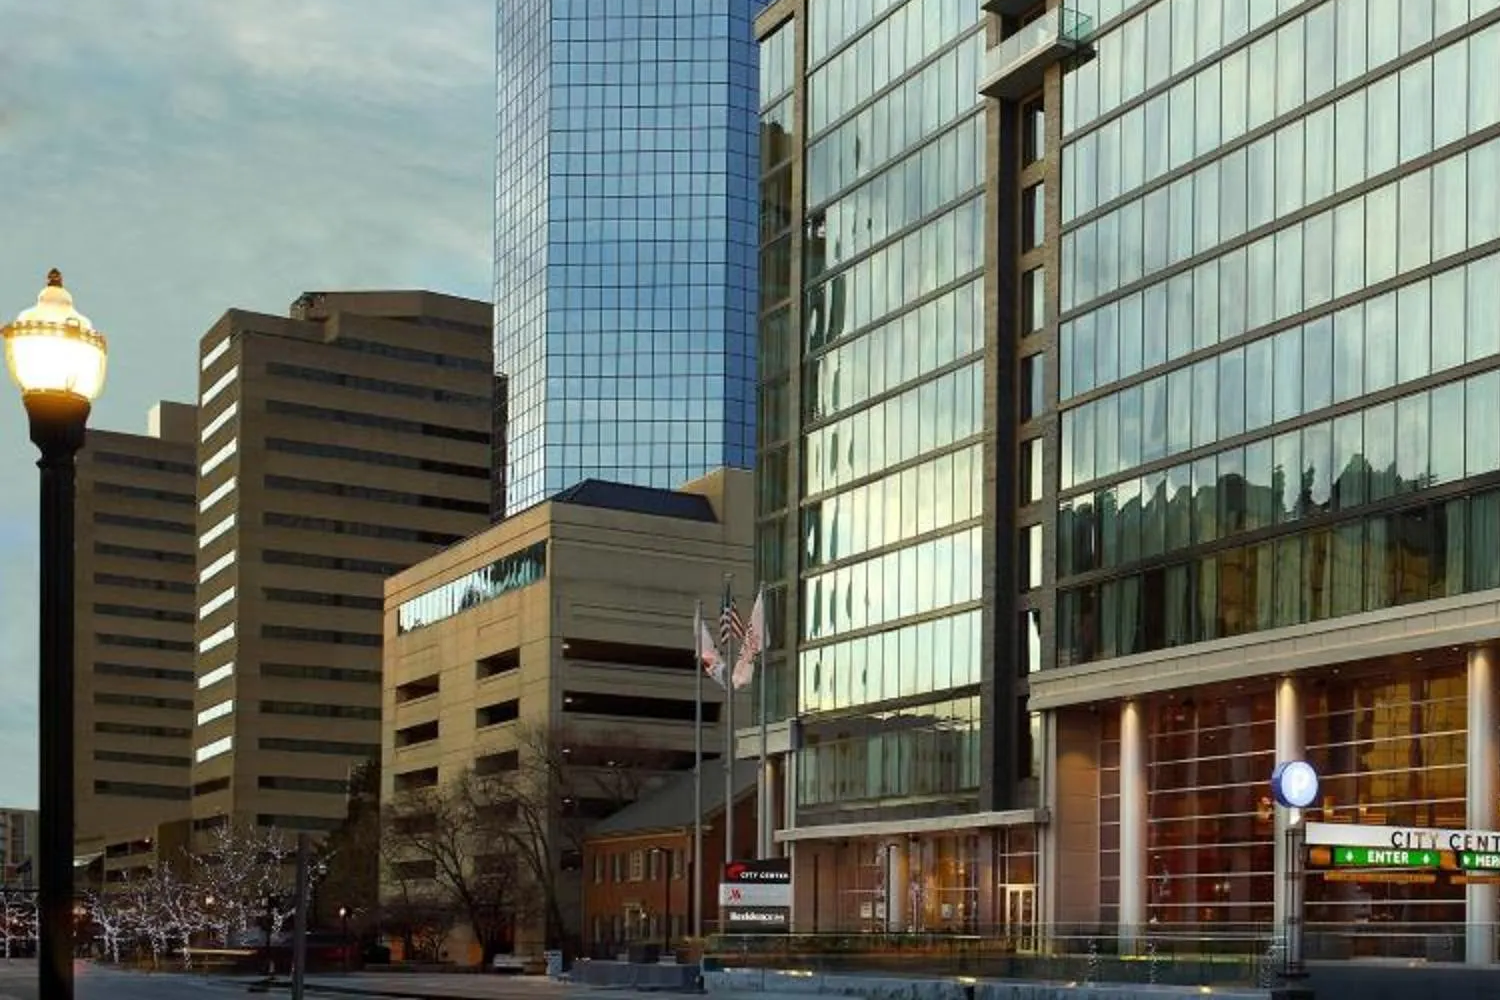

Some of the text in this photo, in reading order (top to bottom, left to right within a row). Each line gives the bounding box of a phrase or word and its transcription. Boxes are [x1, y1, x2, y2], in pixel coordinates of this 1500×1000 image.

[1391, 831, 1438, 849] CITY
[1367, 850, 1409, 864] ENTER
[760, 871, 789, 880] CENTER
